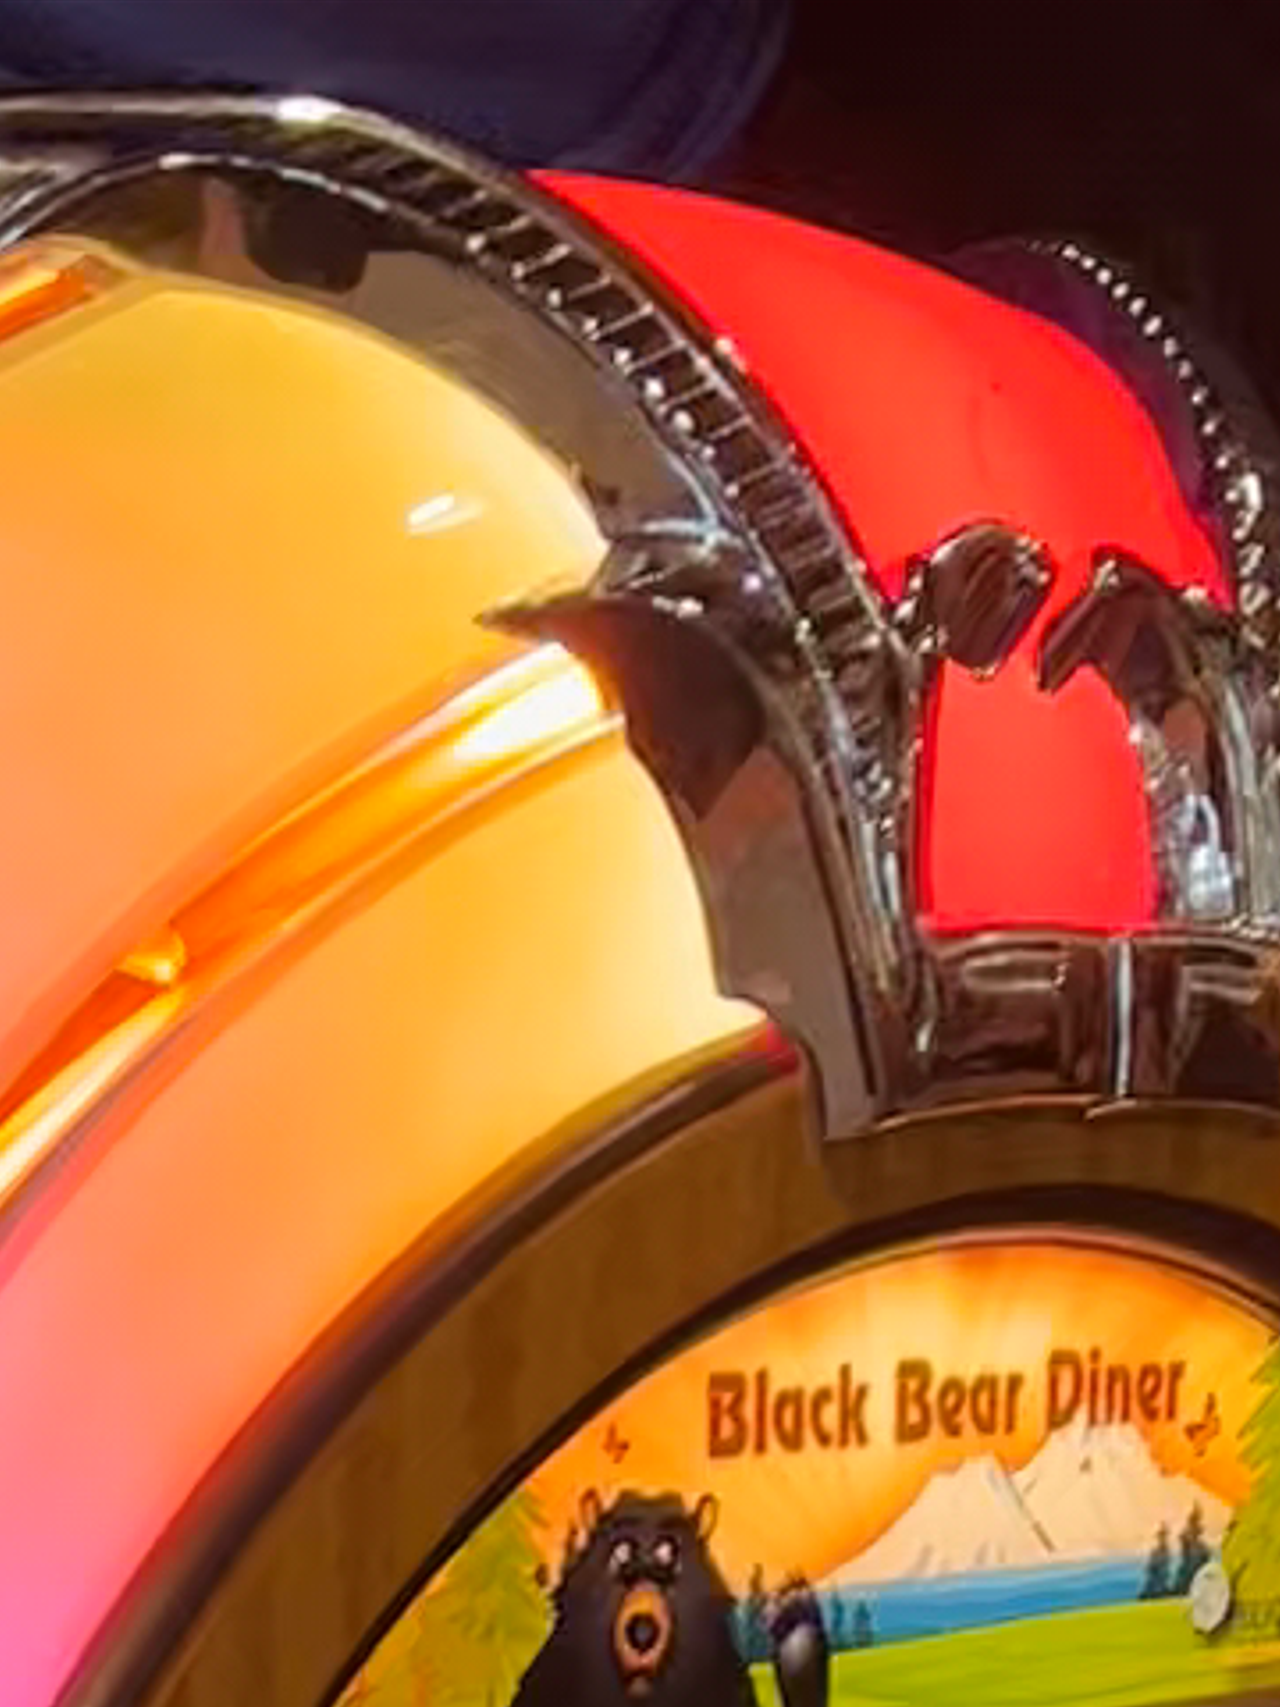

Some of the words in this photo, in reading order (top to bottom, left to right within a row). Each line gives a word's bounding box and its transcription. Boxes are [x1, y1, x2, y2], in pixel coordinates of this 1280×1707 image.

[707, 1364, 870, 1460] Black
[894, 1354, 1023, 1446] Bear
[1047, 1346, 1186, 1432] Diner
